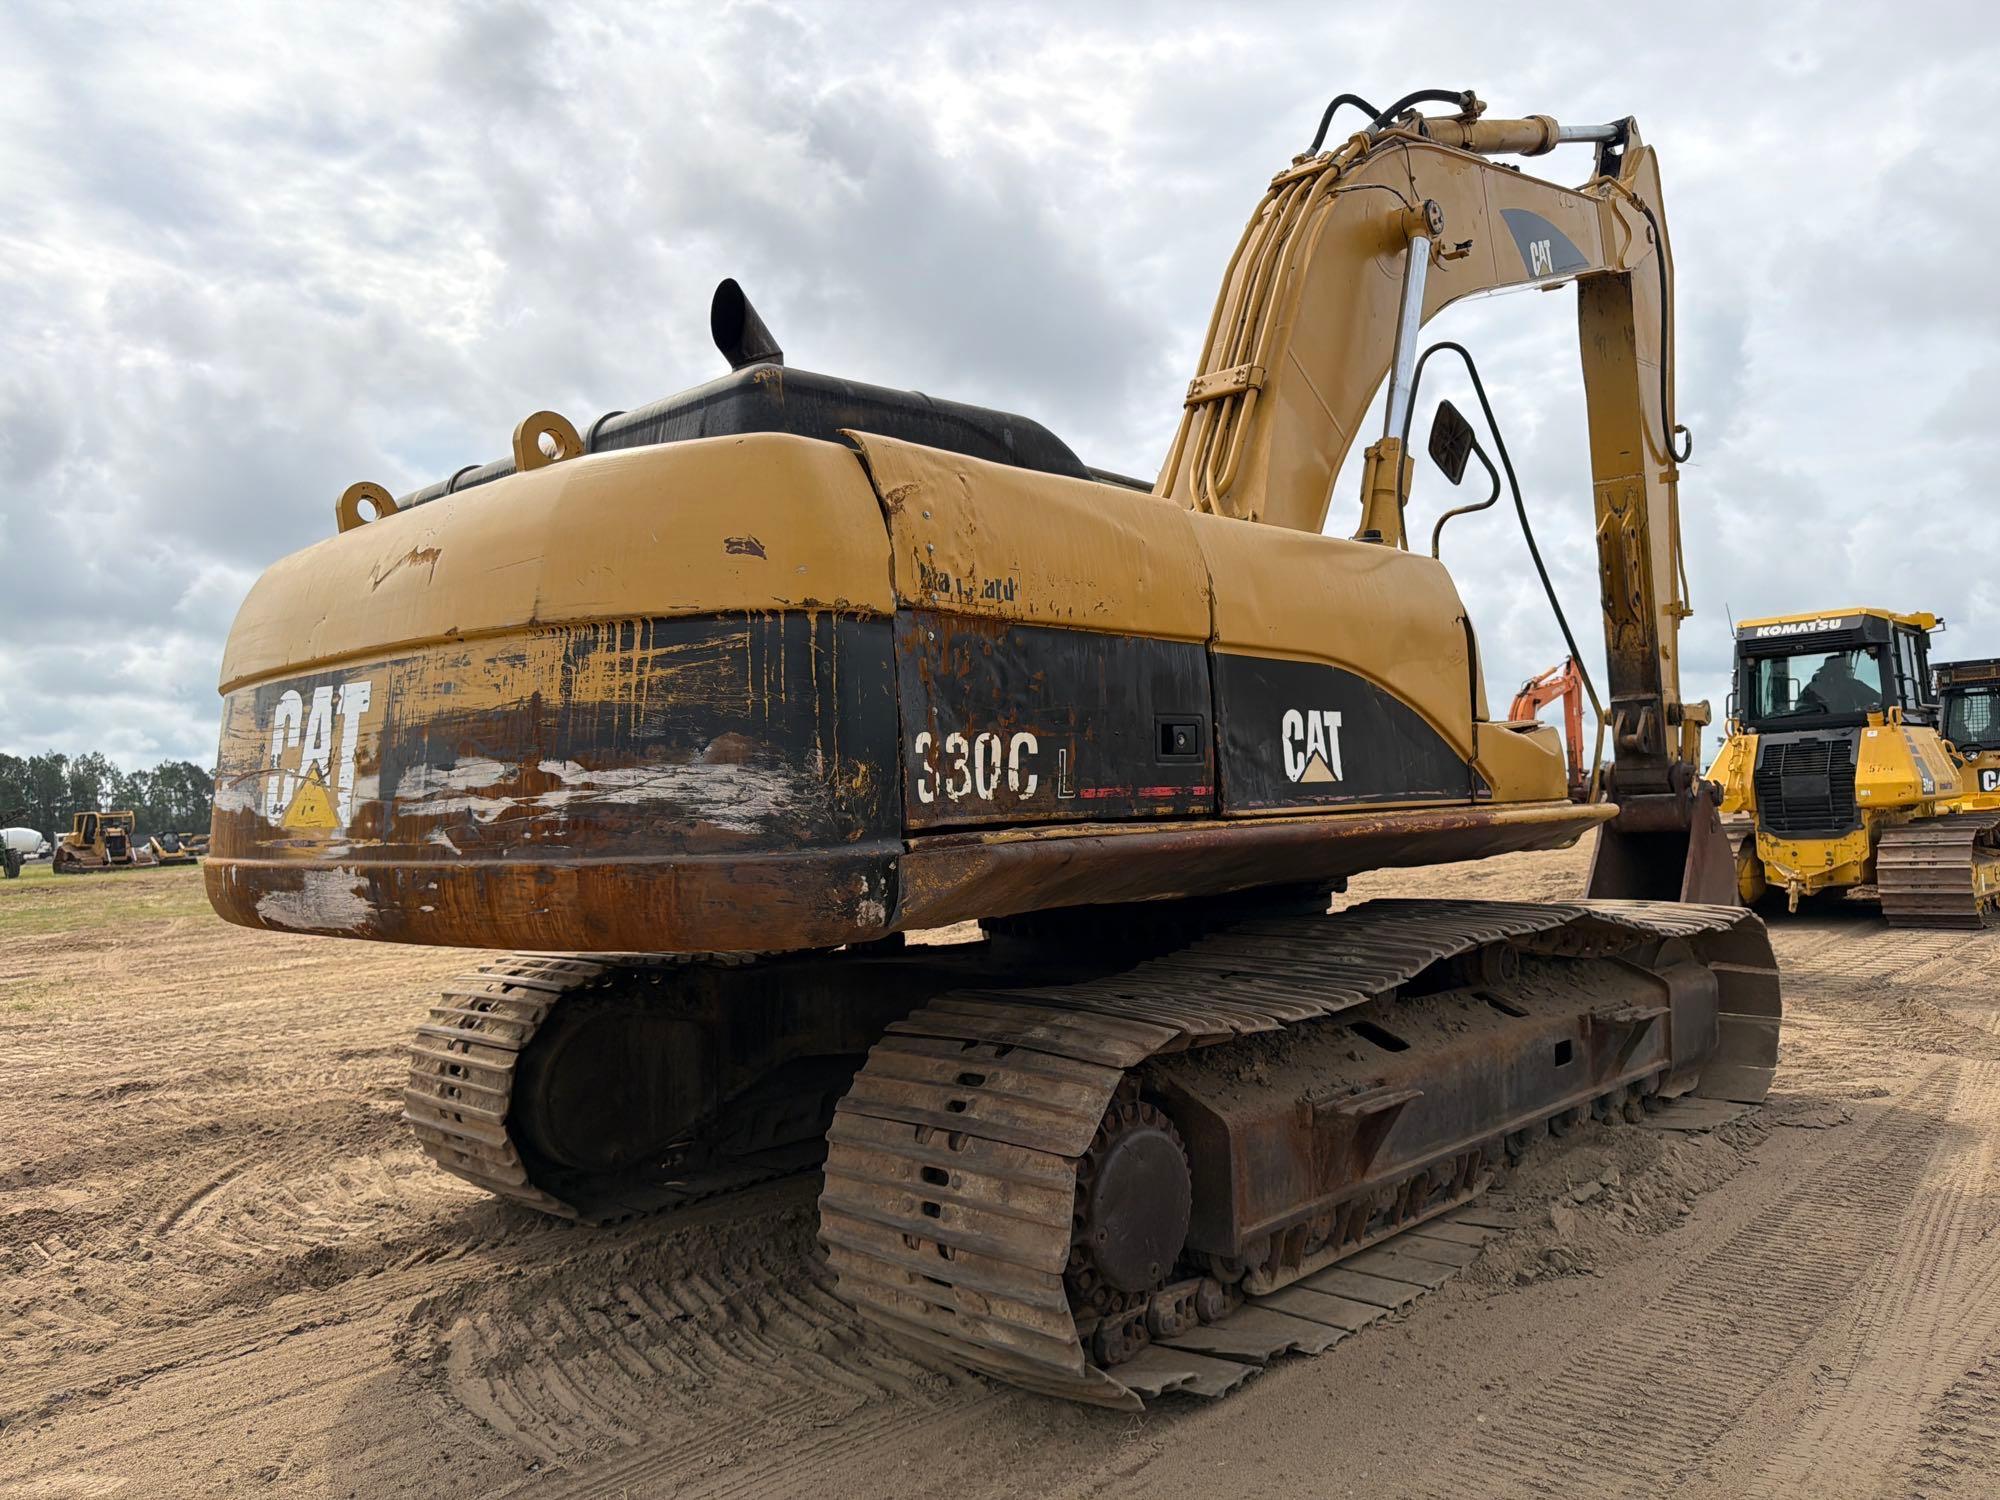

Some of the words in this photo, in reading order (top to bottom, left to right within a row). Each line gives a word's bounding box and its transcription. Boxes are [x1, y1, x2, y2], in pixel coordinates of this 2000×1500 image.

[1530, 240, 1553, 277] CAT
[1756, 619, 1842, 637] KOMATSU
[266, 681, 372, 828] CAT
[915, 732, 1039, 803] 330C
[1057, 749, 1076, 799] L
[1282, 709, 1343, 782] CAT
